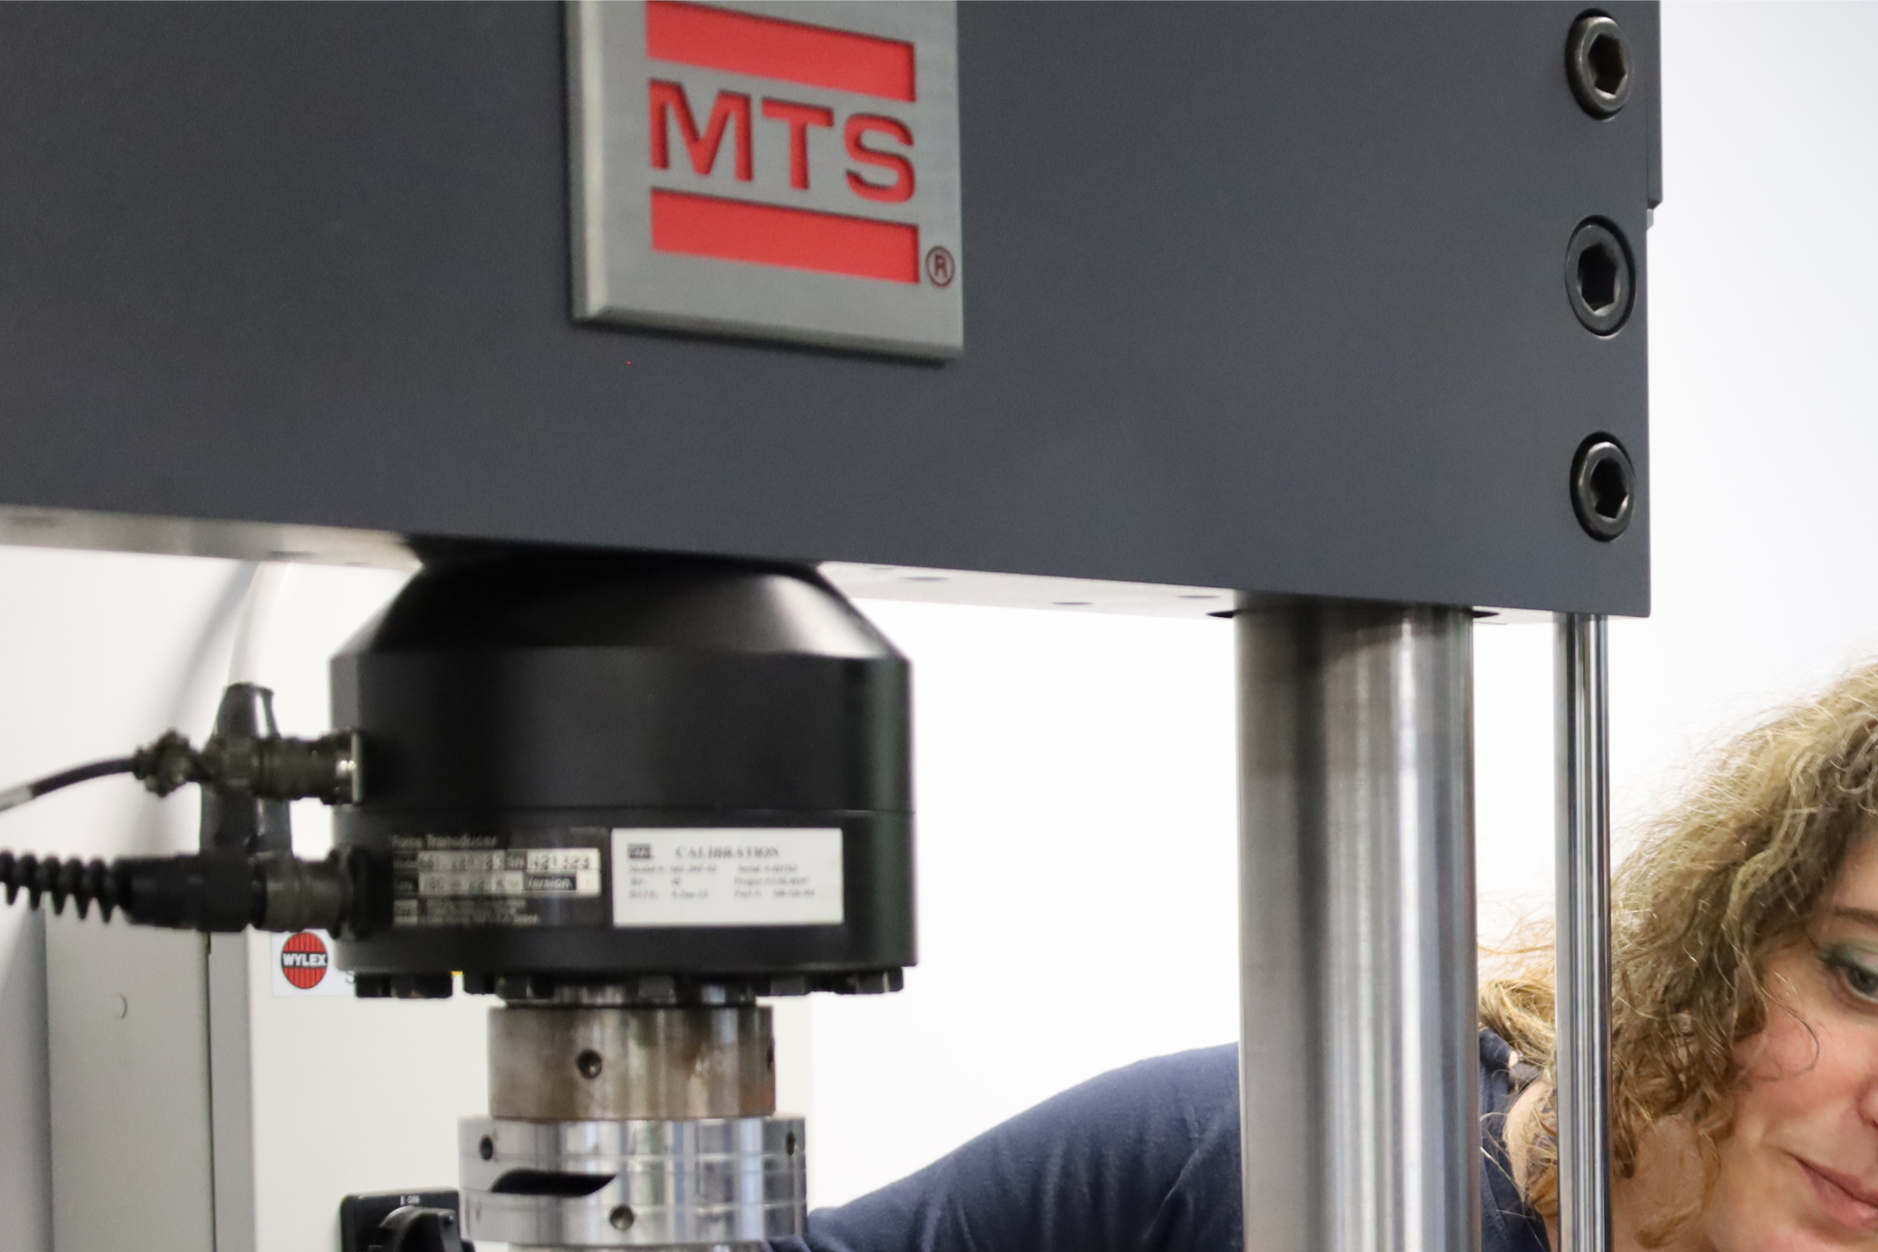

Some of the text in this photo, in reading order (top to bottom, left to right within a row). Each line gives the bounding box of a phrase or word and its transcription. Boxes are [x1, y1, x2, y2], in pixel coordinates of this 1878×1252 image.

[647, 78, 916, 204] MTS
[676, 845, 780, 858] CALIBRATION
[282, 953, 327, 966] WYLEX
